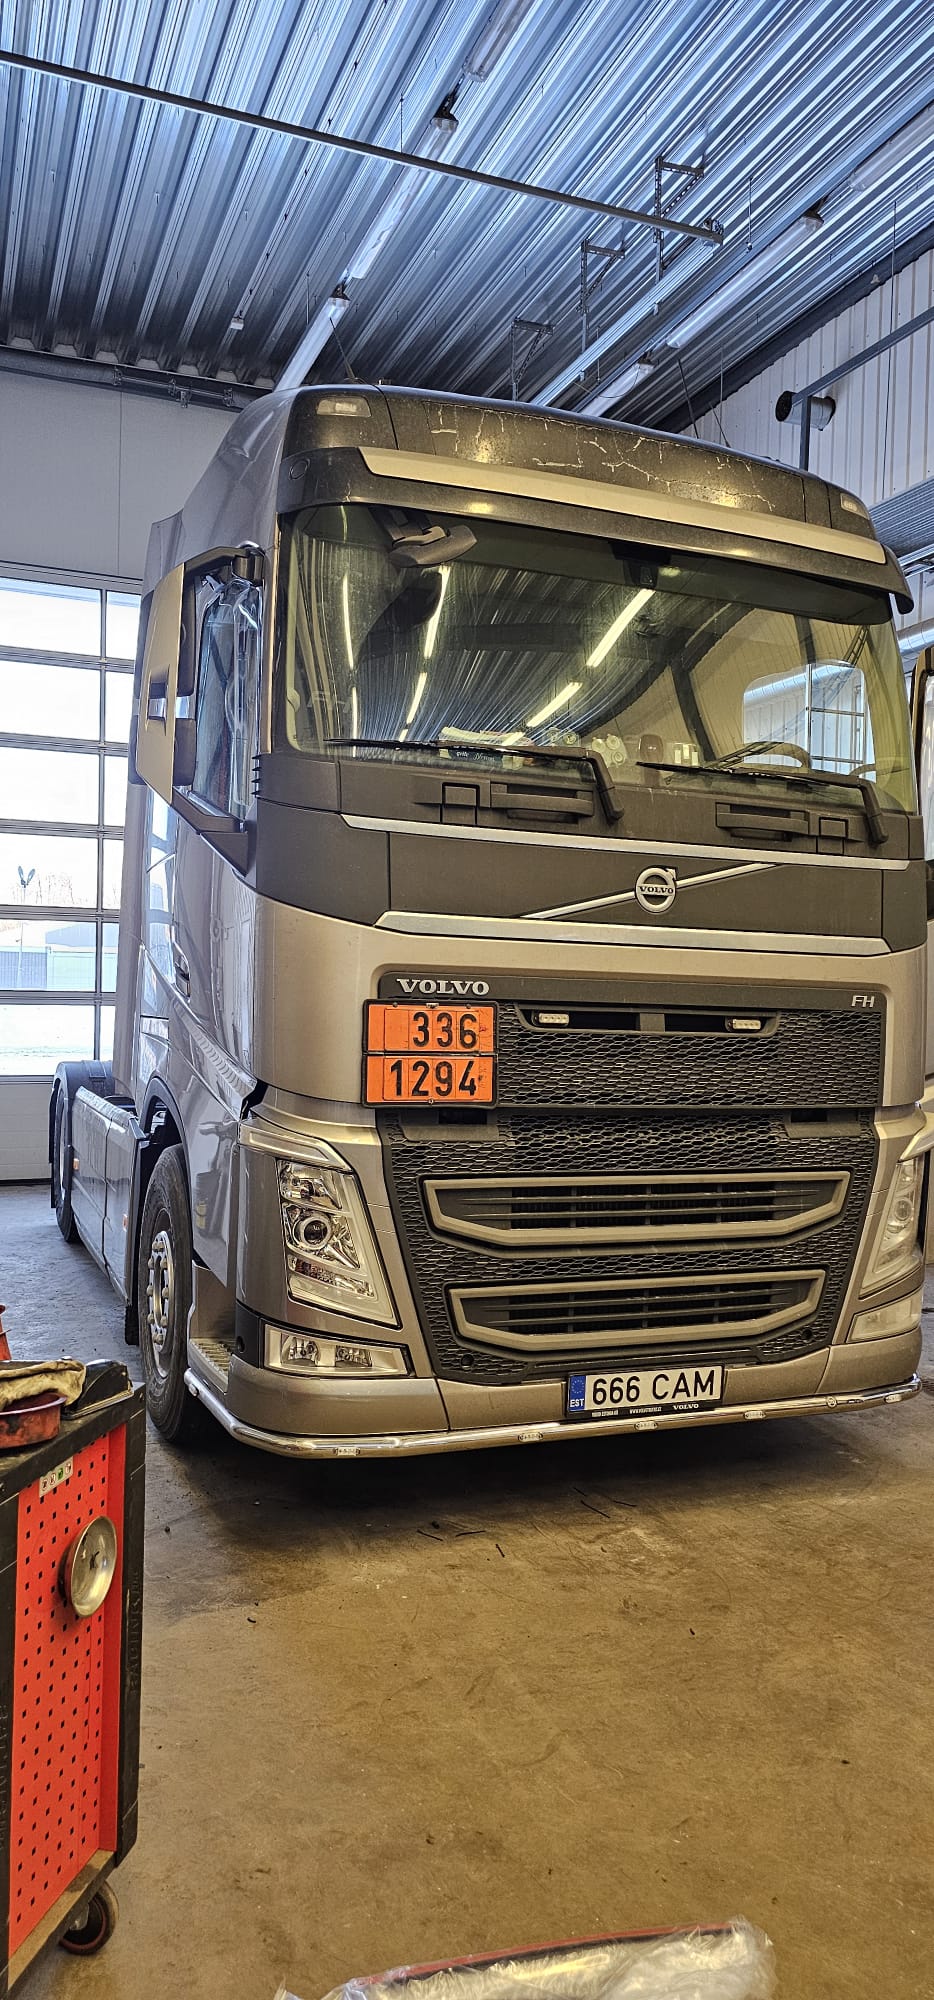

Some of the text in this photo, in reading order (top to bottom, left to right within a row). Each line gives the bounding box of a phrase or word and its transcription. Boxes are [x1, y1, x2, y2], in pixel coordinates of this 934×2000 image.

[638, 886, 674, 894] VOLVO
[397, 978, 490, 996] VOLVO
[851, 995, 875, 1008] FH
[412, 1011, 478, 1049] 336
[390, 1059, 477, 1097] 1294
[592, 1369, 715, 1405] 666 CAM
[569, 1398, 585, 1408] EST
